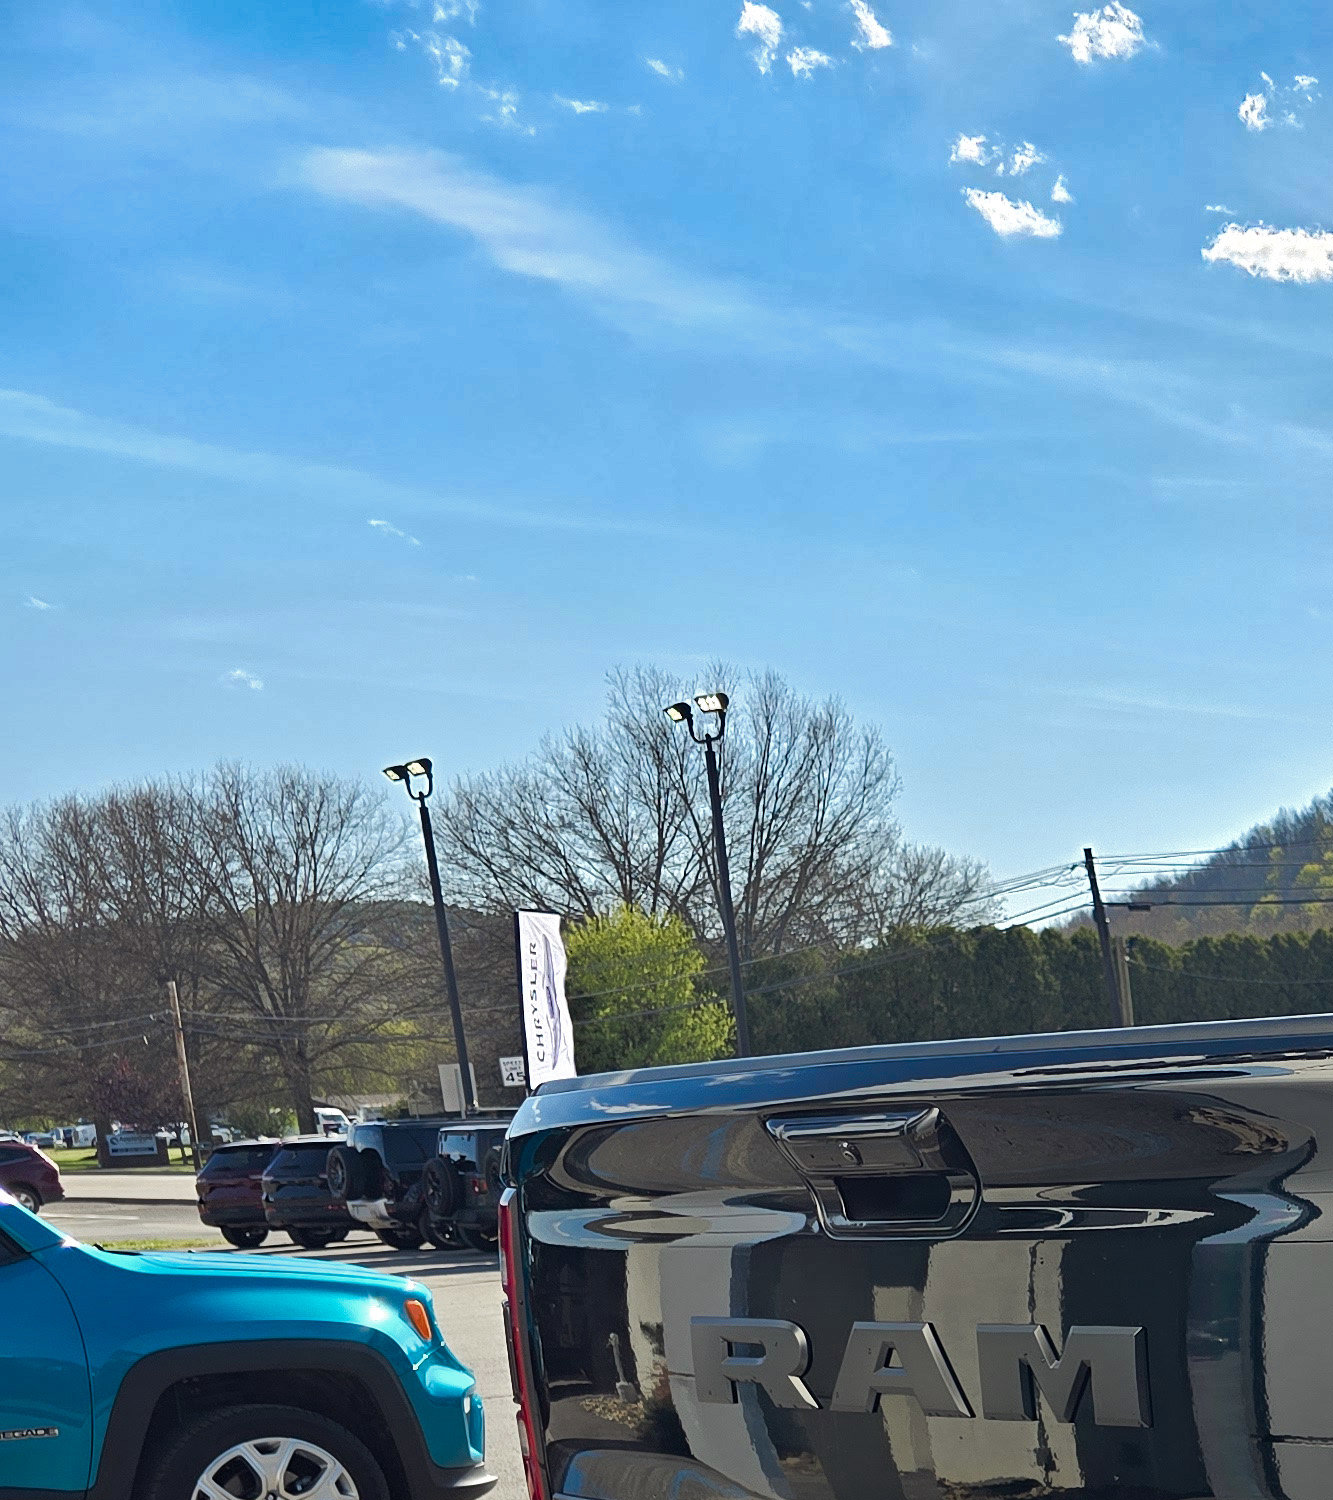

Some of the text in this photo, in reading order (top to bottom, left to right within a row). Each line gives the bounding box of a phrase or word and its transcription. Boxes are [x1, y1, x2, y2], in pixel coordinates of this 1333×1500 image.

[530, 942, 545, 1062] CHRYSLER
[505, 1072, 525, 1082] 45
[690, 1316, 1154, 1428] RAM
